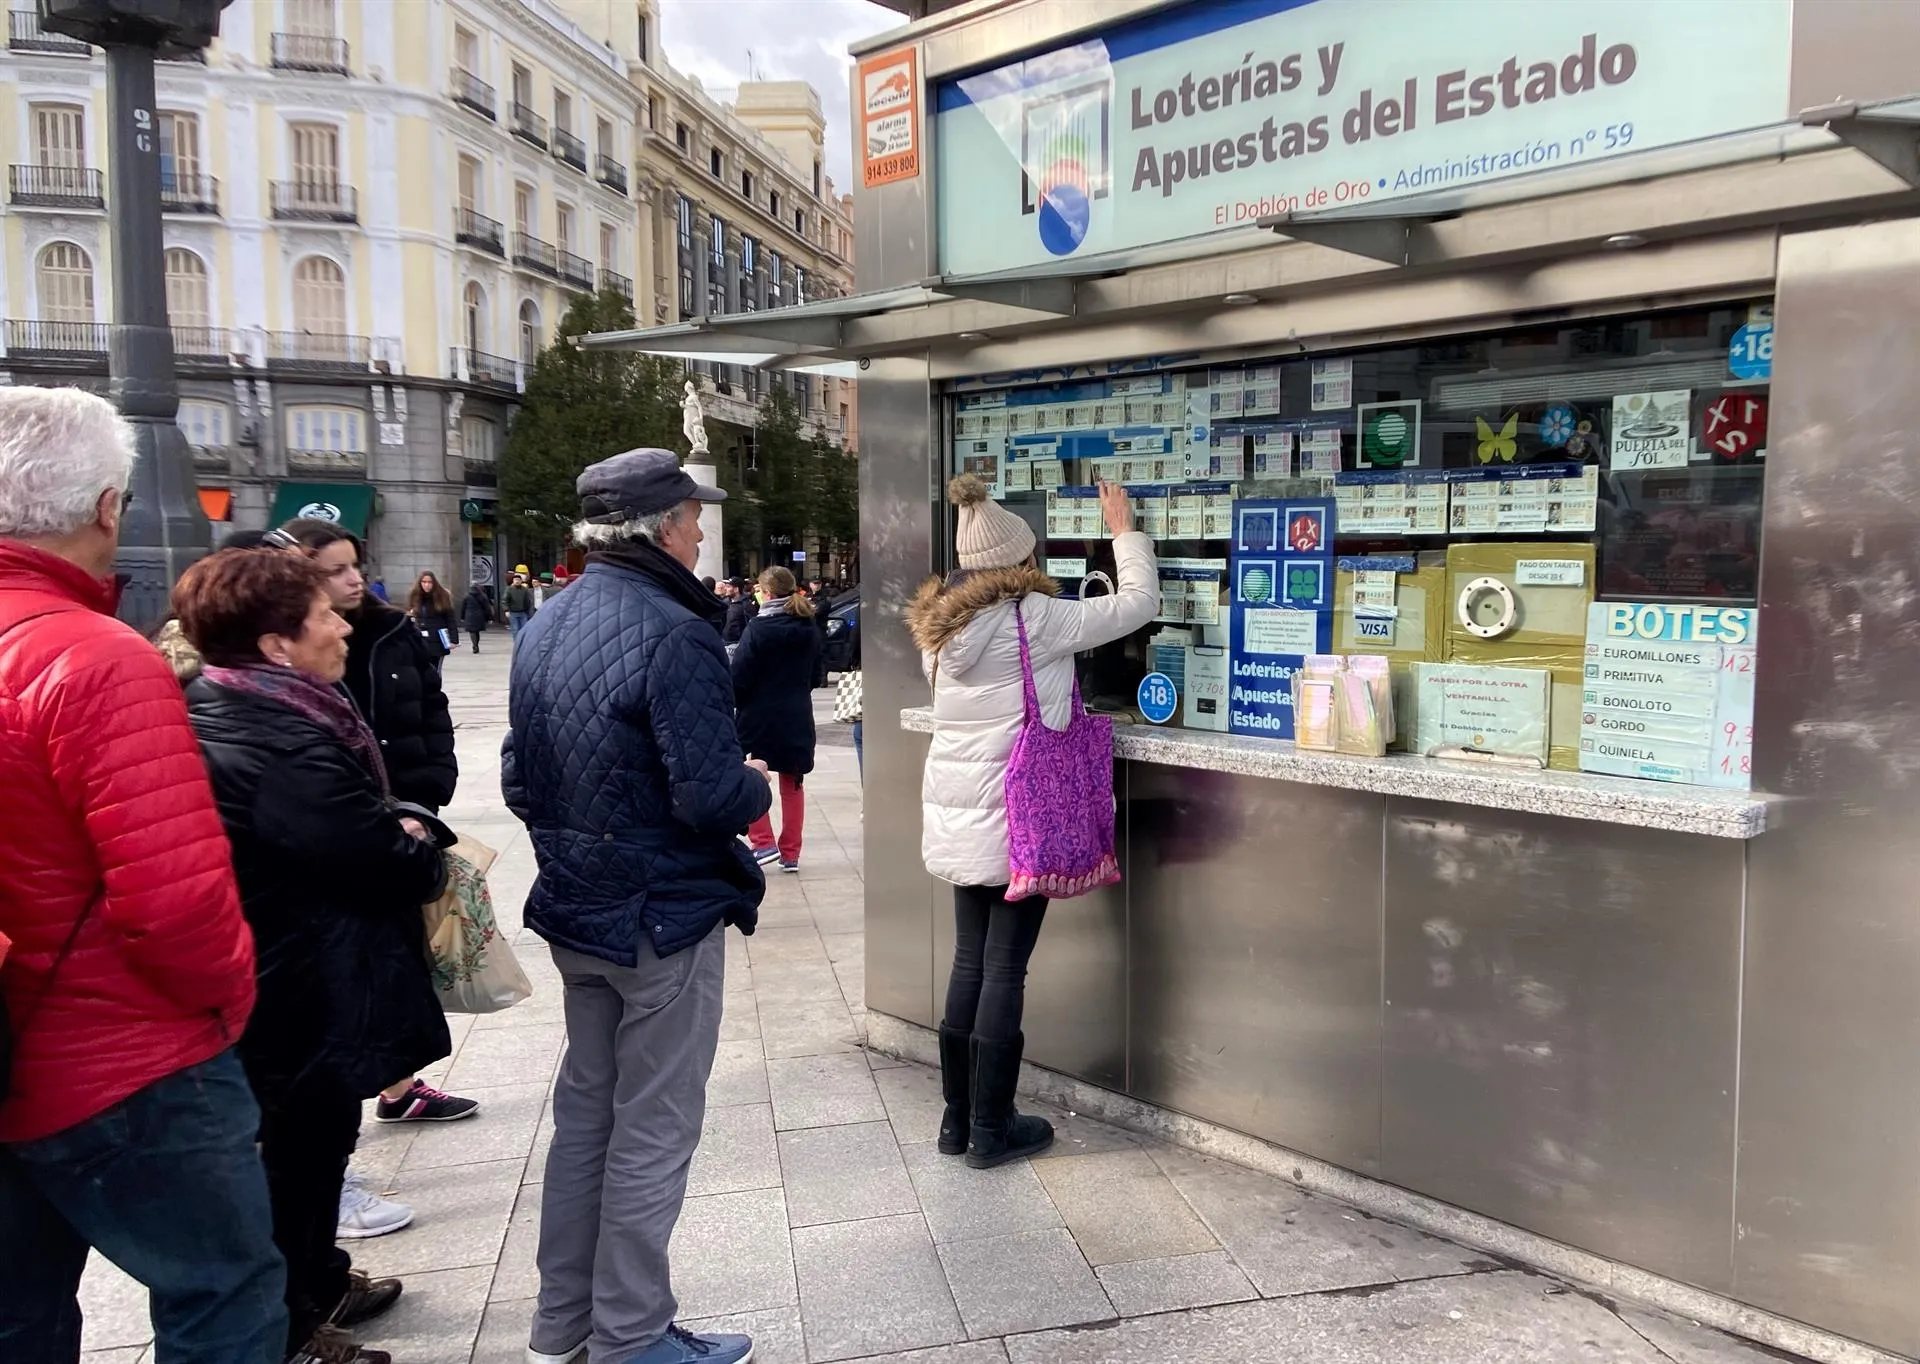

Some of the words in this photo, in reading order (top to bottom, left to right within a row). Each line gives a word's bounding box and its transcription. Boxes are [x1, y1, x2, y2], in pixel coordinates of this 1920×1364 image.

[1131, 51, 1302, 130] Loterías
[1317, 41, 1345, 97] y
[877, 116, 907, 132] alarma
[1131, 116, 1330, 198] Apuestas
[1342, 77, 1418, 145] del
[1435, 33, 1638, 125] Estado
[867, 165, 881, 180] 914
[883, 160, 898, 176] 339
[900, 155, 915, 170] 800
[1215, 206, 1229, 225] El
[1235, 193, 1299, 219] Doblón
[1305, 187, 1328, 208] de
[1335, 181, 1371, 202] Oro
[1393, 141, 1560, 191] Administración
[1570, 130, 1596, 158] nº
[1603, 122, 1634, 150] 59
[1730, 333, 1773, 361] +18
[1615, 439, 1668, 453] PUERTA
[1669, 438, 1687, 449] DEL
[1629, 451, 1663, 467] SOL
[1294, 521, 1301, 536] 1
[1306, 520, 1317, 538] X
[1297, 537, 1314, 550] 2
[1360, 623, 1389, 636] VISA
[1607, 605, 1748, 644] BOTES
[1604, 648, 1701, 665] EUROMILLONES
[1234, 660, 1291, 679] Loterías
[1604, 670, 1664, 684] PRIMITIVA
[1142, 685, 1168, 706] +18
[1603, 697, 1672, 712] BONOLOTO
[1233, 711, 1281, 730] Estado
[1601, 718, 1645, 732] GORDO
[1599, 744, 1655, 761] QUINIELA
